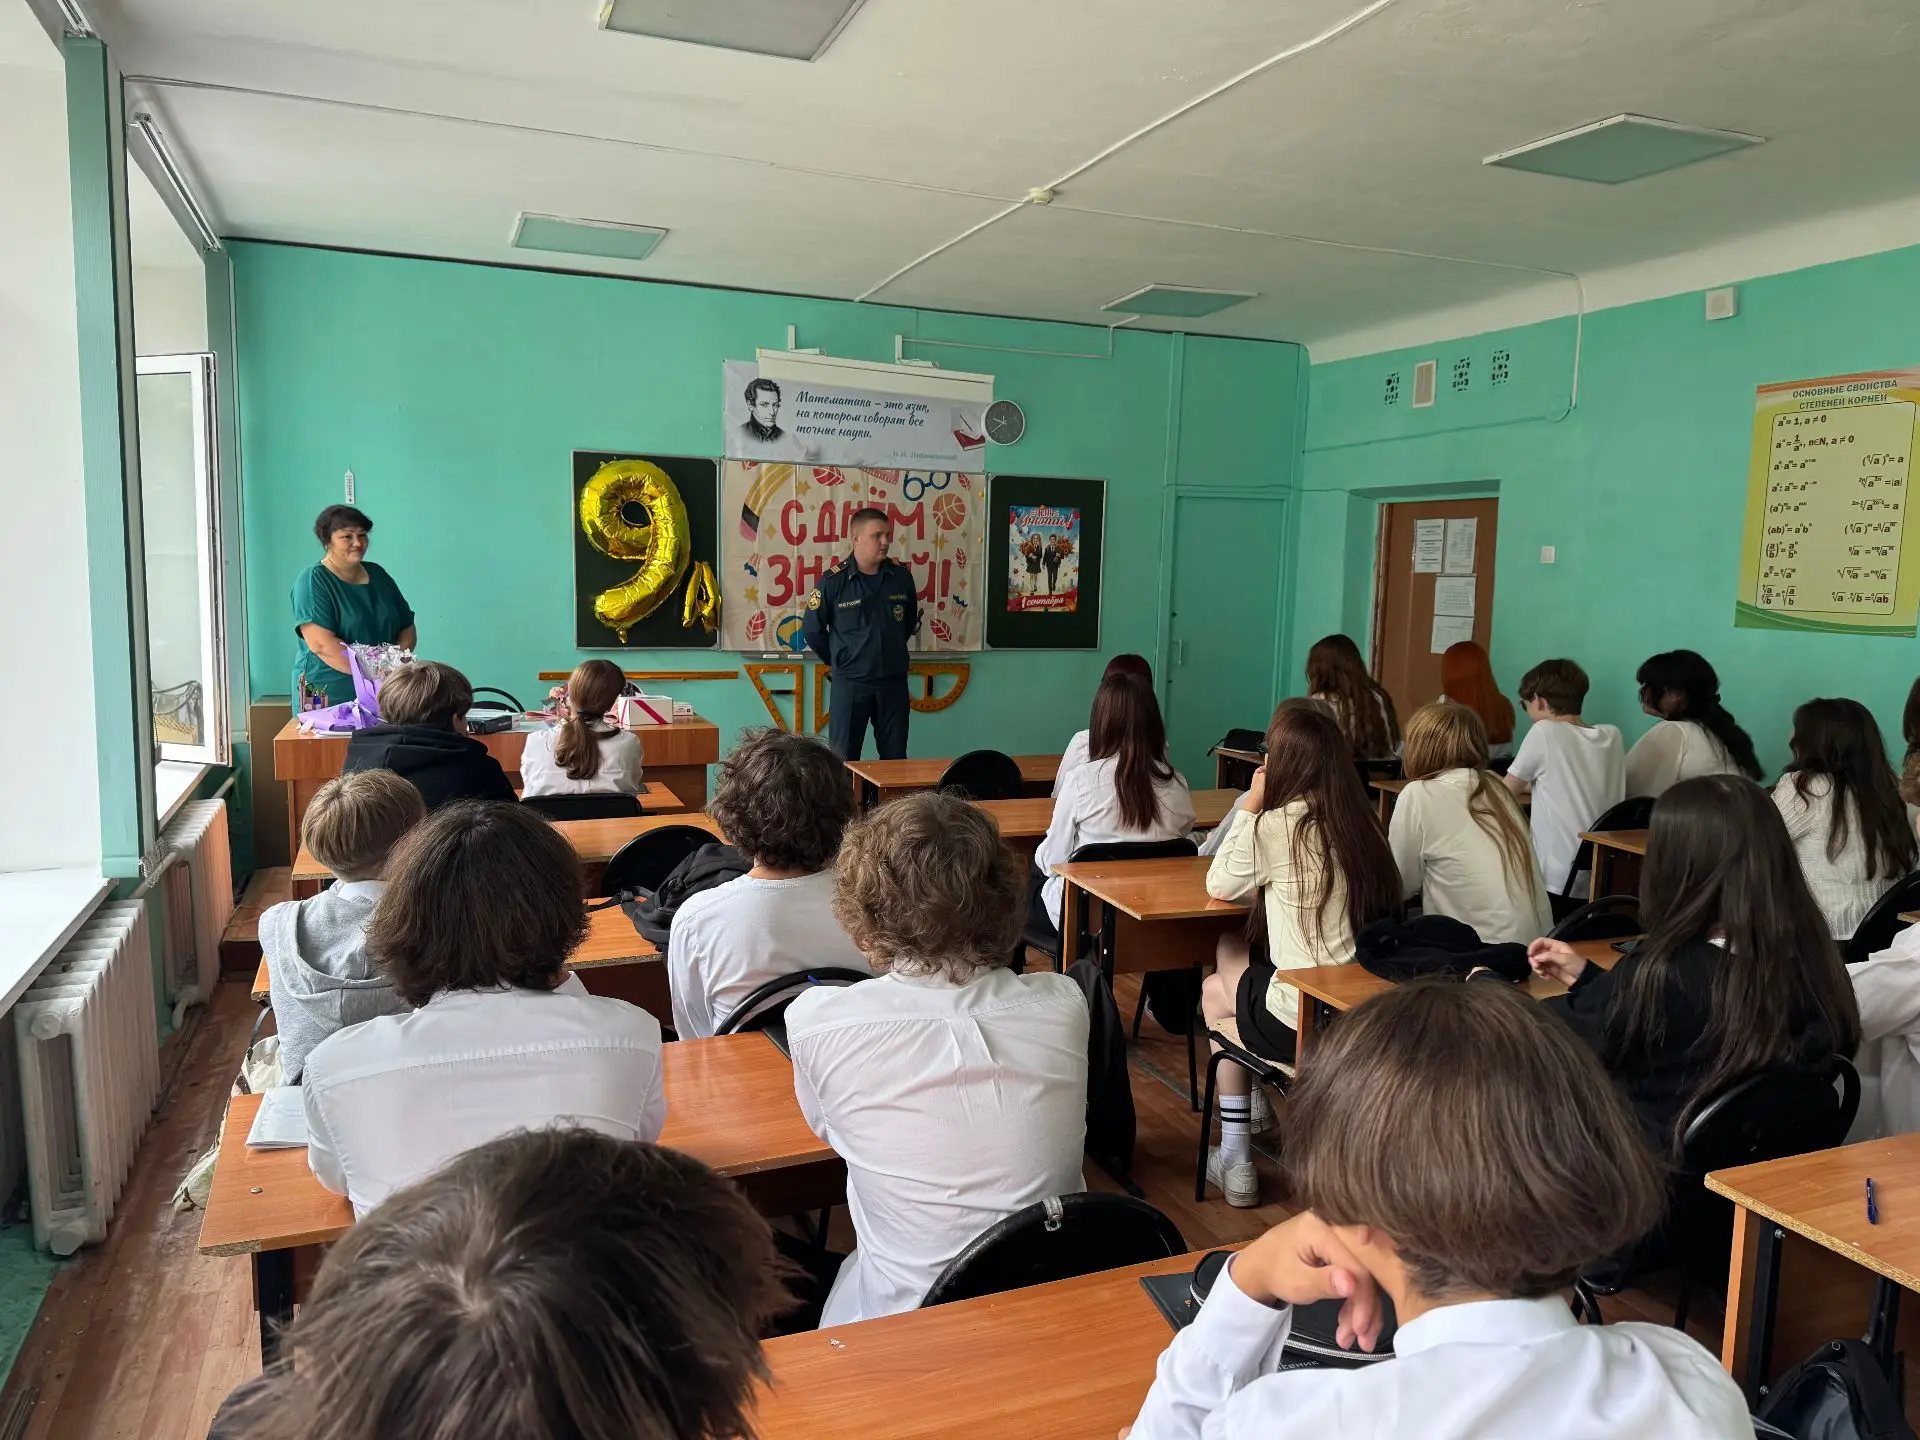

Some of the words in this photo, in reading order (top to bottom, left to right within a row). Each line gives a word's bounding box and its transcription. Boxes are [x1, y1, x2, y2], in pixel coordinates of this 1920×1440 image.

[1793, 386, 1844, 399] ОСНОВНЫЕ
[1847, 379, 1897, 392] СВОЙСТВА
[796, 391, 872, 408] Математика
[884, 401, 903, 410] это
[1799, 398, 1845, 410] СТЕПЕНЕЙ
[1848, 393, 1887, 405] КОРНЕЙ
[796, 409, 810, 418] на
[813, 410, 861, 424] котором
[864, 412, 905, 428] говорят
[908, 415, 924, 427] все
[838, 428, 872, 441] науки.
[781, 499, 807, 546] С
[1021, 597, 1026, 608] 1
[1026, 596, 1064, 607] сентября
